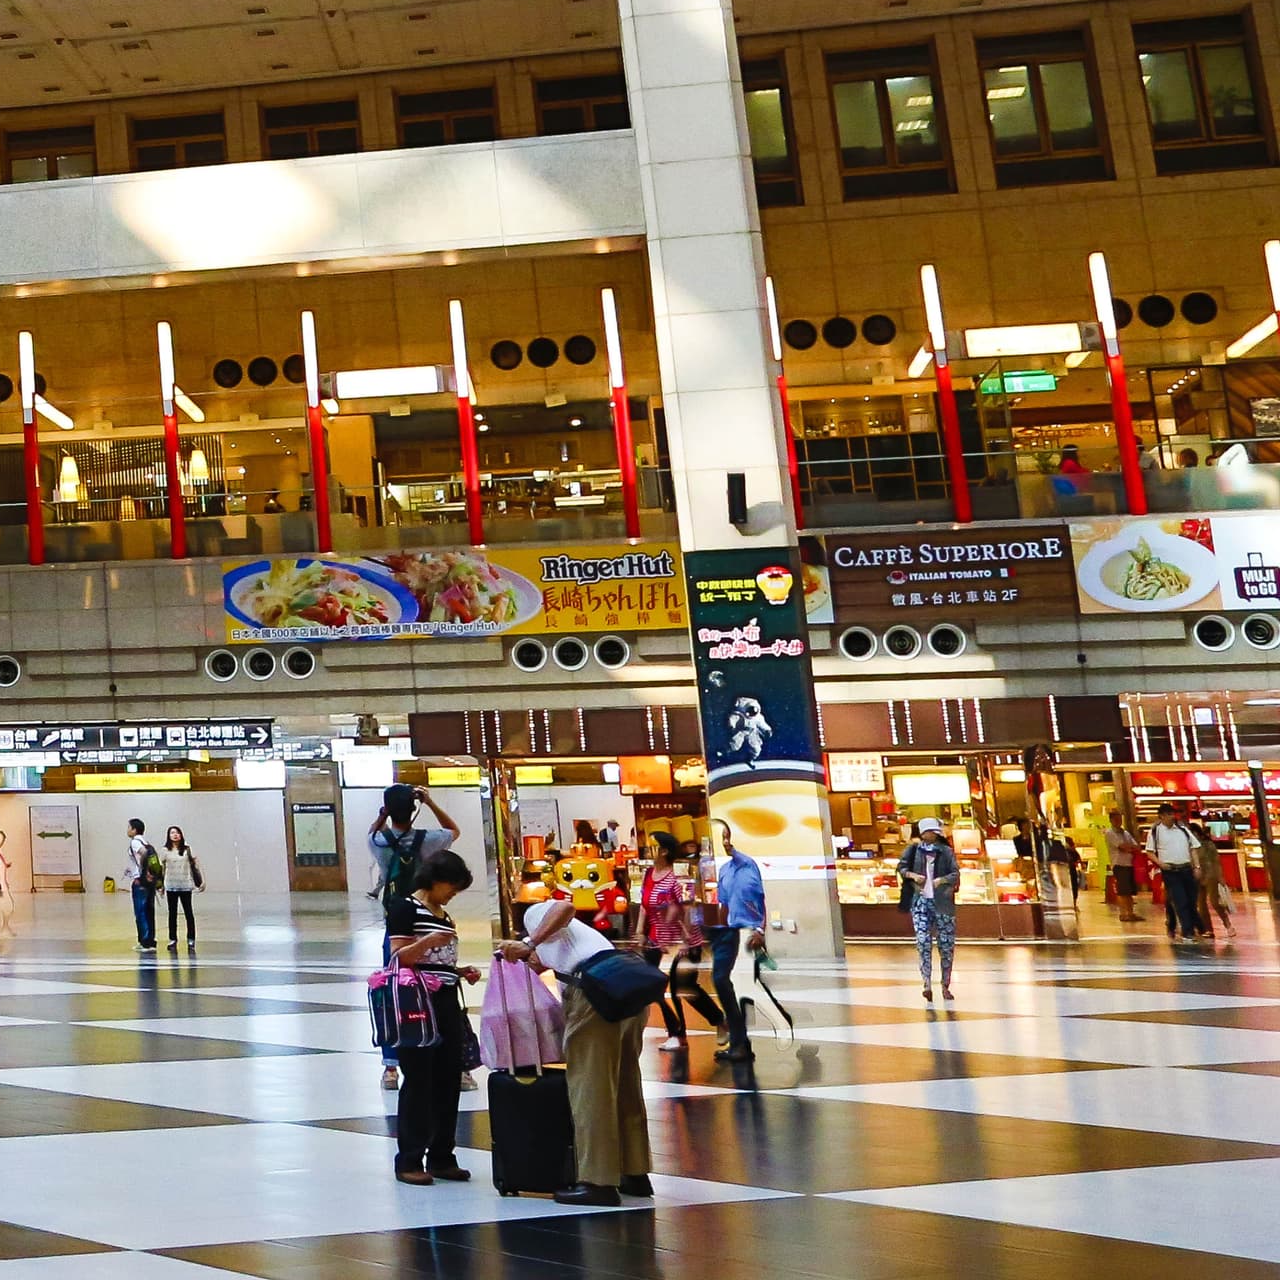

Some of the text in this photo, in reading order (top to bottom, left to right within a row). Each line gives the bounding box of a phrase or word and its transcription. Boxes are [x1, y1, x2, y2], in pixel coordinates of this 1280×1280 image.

[834, 537, 1063, 567] CAFFÈ SUPERIORE
[541, 550, 675, 585] Ringer Hut
[908, 569, 992, 581] ITALIAN TOMATO
[1241, 569, 1276, 583] MUJI
[542, 582, 684, 614] 長崎ちゃんぽん
[1001, 589, 1018, 601] 2F
